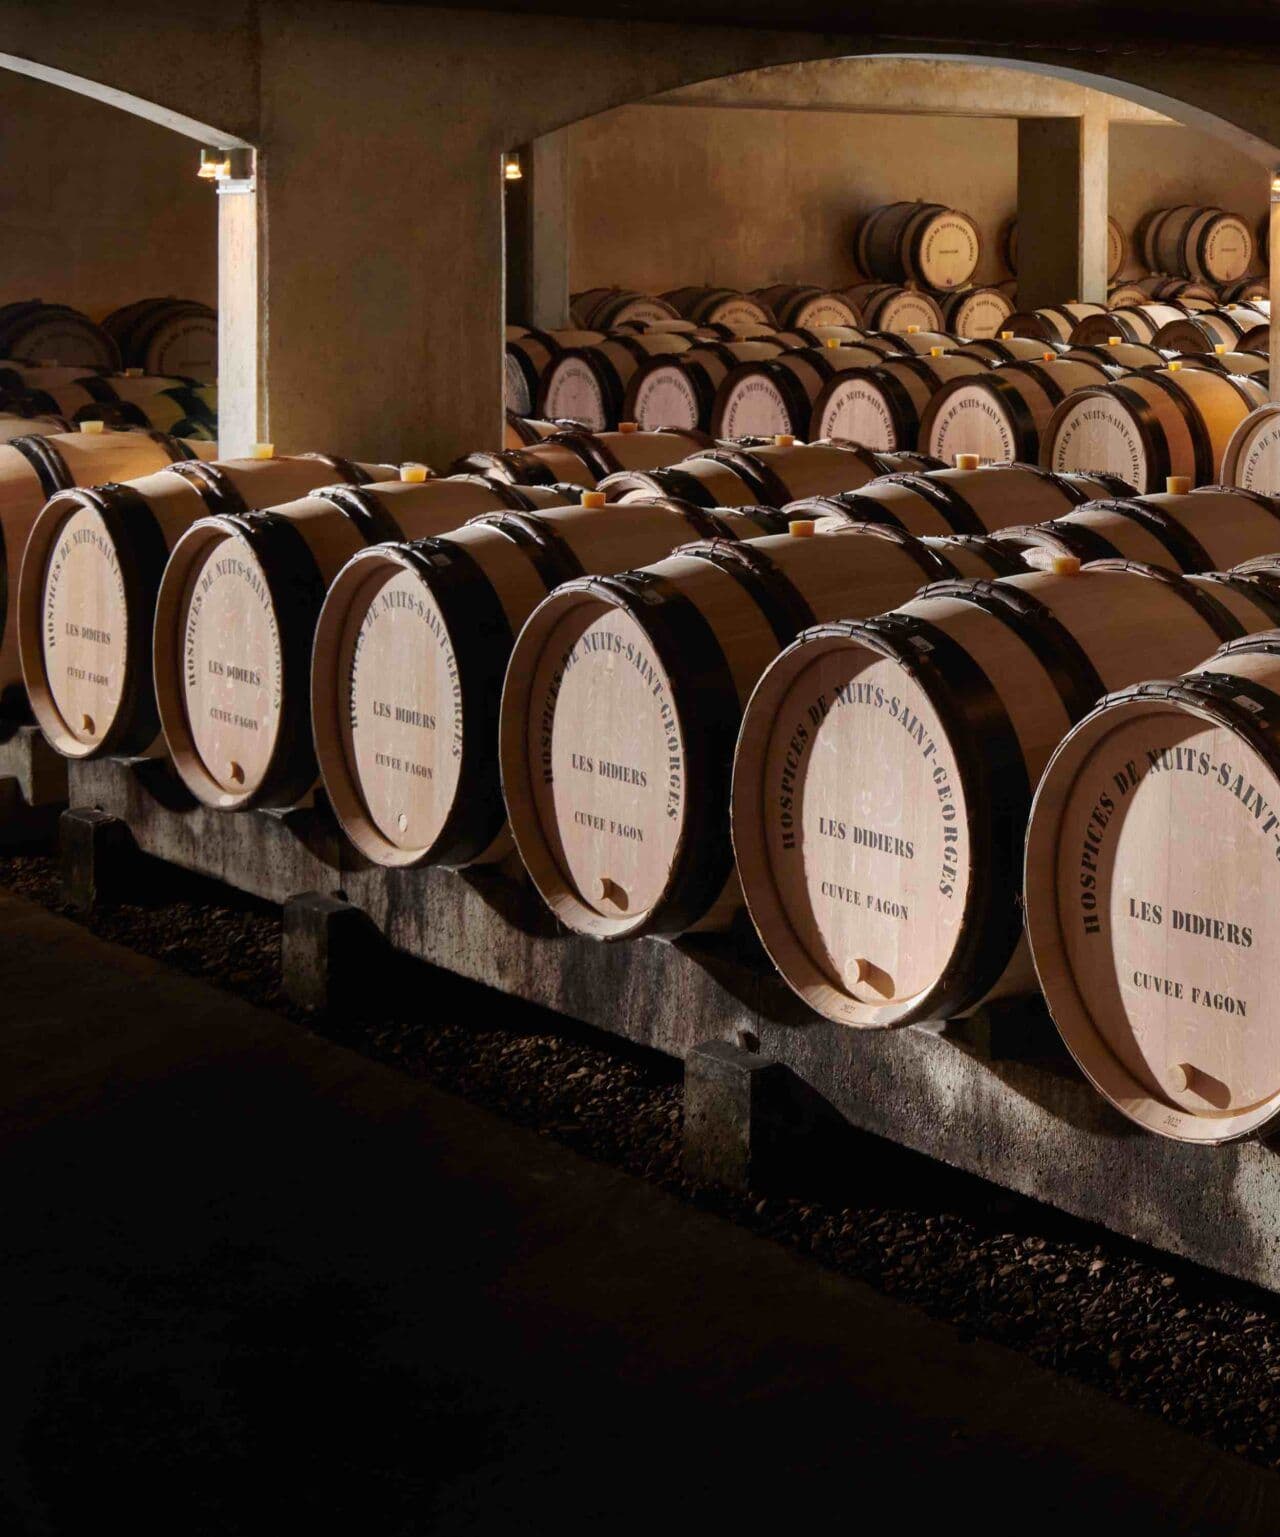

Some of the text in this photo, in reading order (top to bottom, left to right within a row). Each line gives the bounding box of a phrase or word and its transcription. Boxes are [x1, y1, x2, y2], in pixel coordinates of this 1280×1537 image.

[1082, 410, 1140, 484] NUITS-SAINT-GEORGE
[1246, 451, 1259, 490] SPICES
[202, 570, 216, 590] DE
[366, 602, 380, 628] DE
[66, 622, 112, 646] LES DIDIERS
[208, 660, 261, 687] LES DIDIERS
[210, 707, 258, 732] CUVEE FAGON
[372, 701, 436, 730] LES DIDIERS
[562, 644, 581, 674] DE
[583, 631, 682, 823] NUITS-SAINT-GEORGES
[374, 752, 434, 780] CUVEE FAGON
[572, 753, 648, 788] LES DIDIERS
[776, 682, 960, 900] HOSPICES DE NUITS-SAINT-GEORGES
[574, 810, 644, 842] CUVEE FAGON
[818, 816, 914, 860] LES DIDIERS
[1078, 792, 1115, 936] HOSPICES
[1112, 760, 1142, 794] DE
[820, 880, 910, 922] CUVEE FAGON
[1129, 898, 1253, 948] LES DIDIERS
[1133, 970, 1248, 1018] CUVEE FAGON
